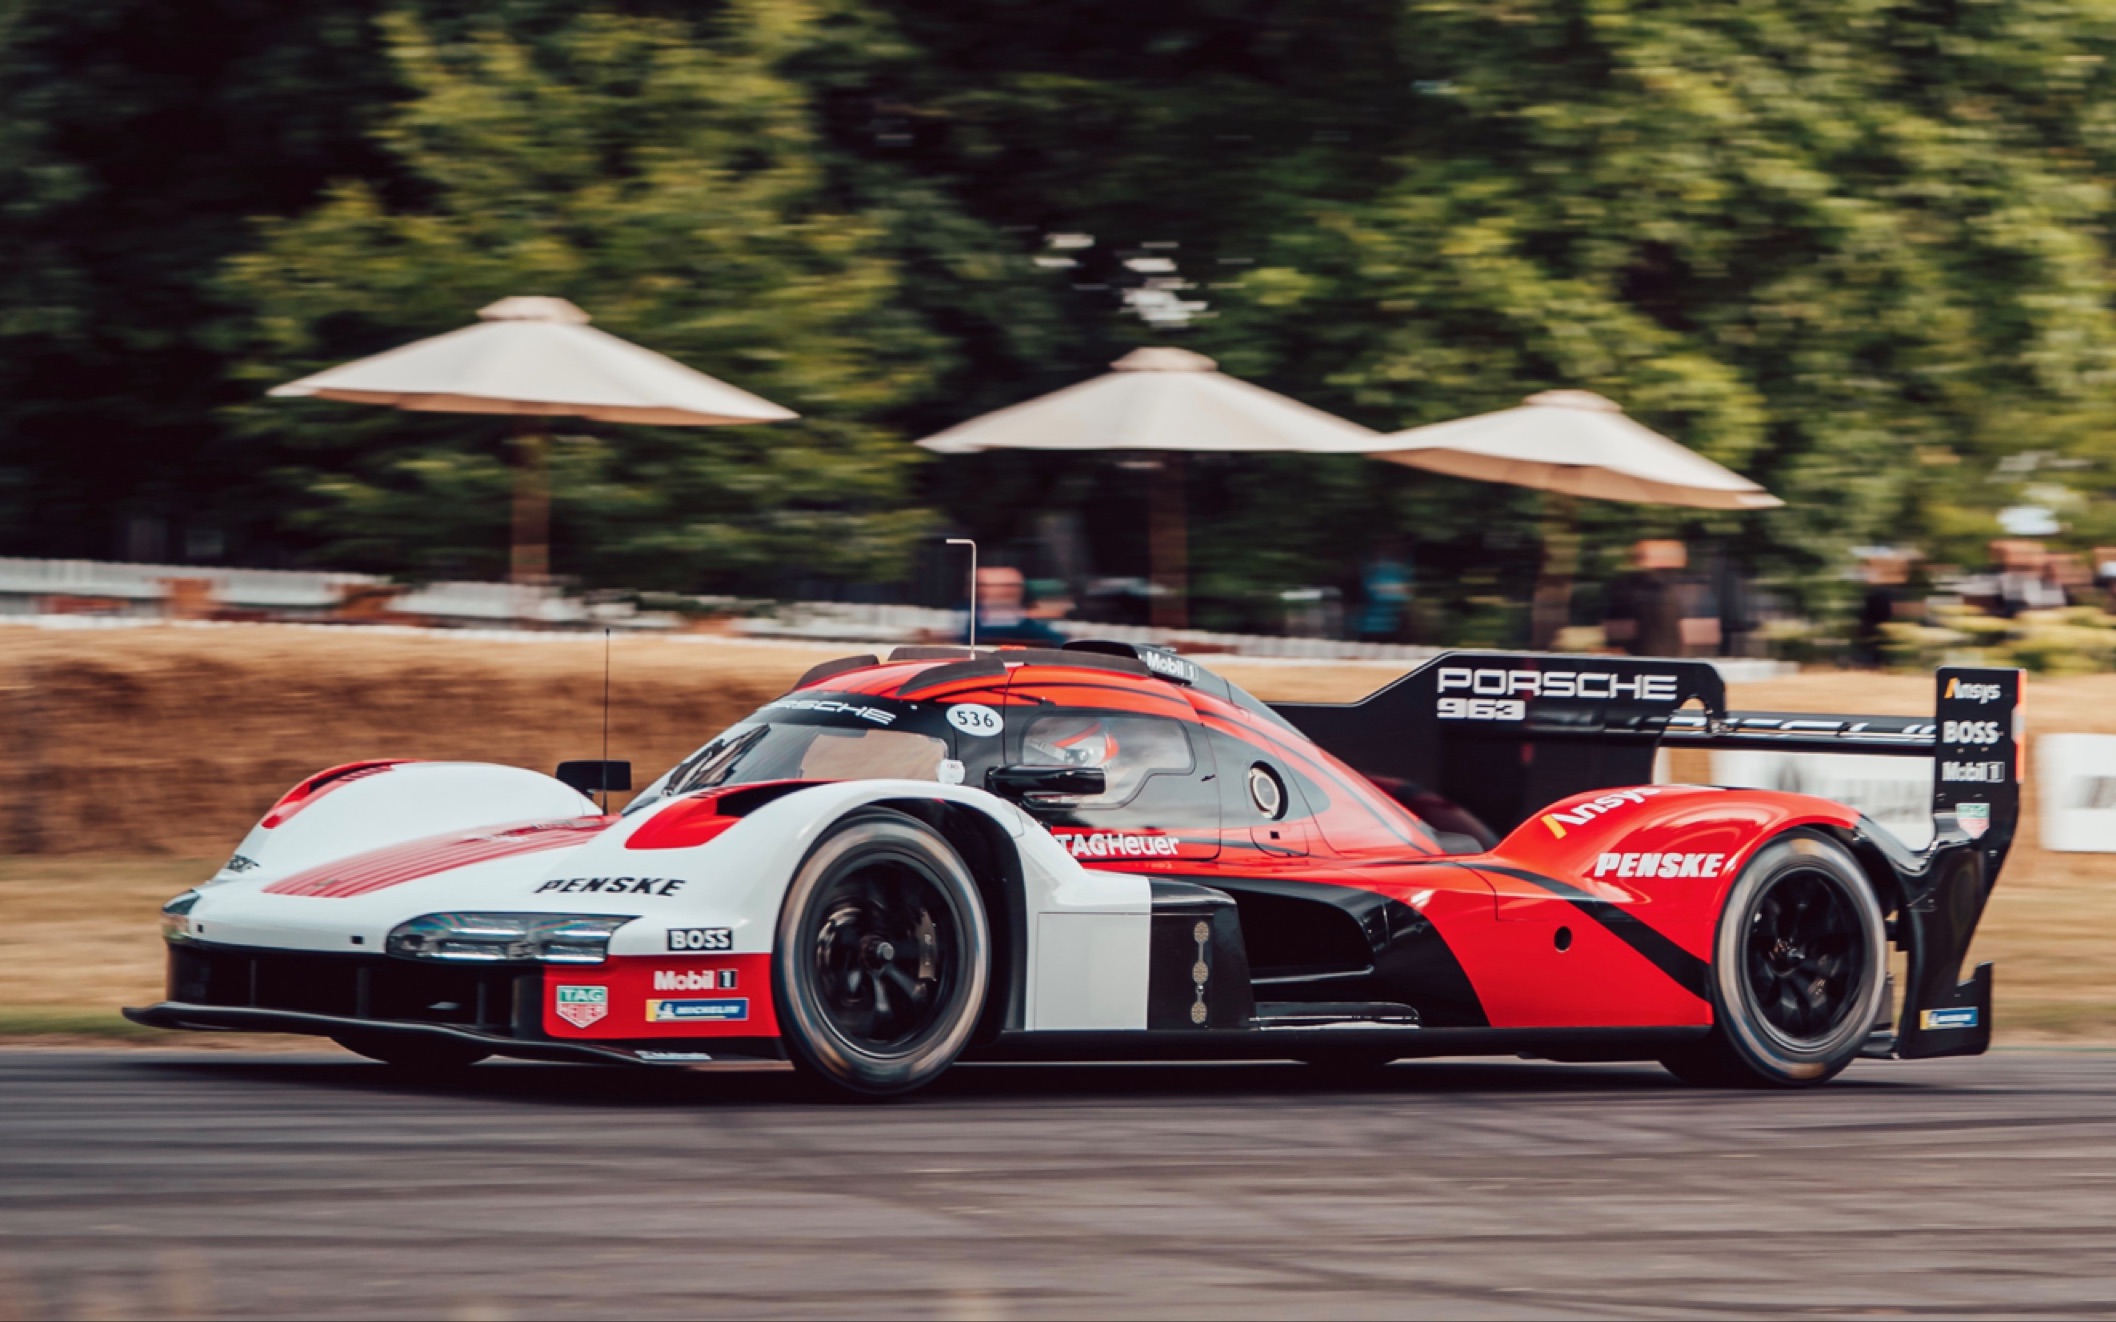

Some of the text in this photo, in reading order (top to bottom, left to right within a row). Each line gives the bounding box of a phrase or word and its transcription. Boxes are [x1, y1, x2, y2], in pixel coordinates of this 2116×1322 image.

[1146, 651, 1184, 677] Mobil
[1437, 667, 1678, 700] PORSCHE
[1944, 677, 2002, 704] Ansys
[956, 710, 994, 728] 536
[1437, 698, 1525, 720] 963
[1943, 720, 2000, 744] BOSS
[1942, 761, 1987, 782] Mobil
[1541, 787, 1661, 839] Ansys
[1594, 852, 1725, 878] PENSKE
[534, 877, 686, 896] PENSKE
[670, 929, 730, 949] BOSS
[653, 970, 714, 990] Mobil
[560, 988, 604, 1001] TAG
